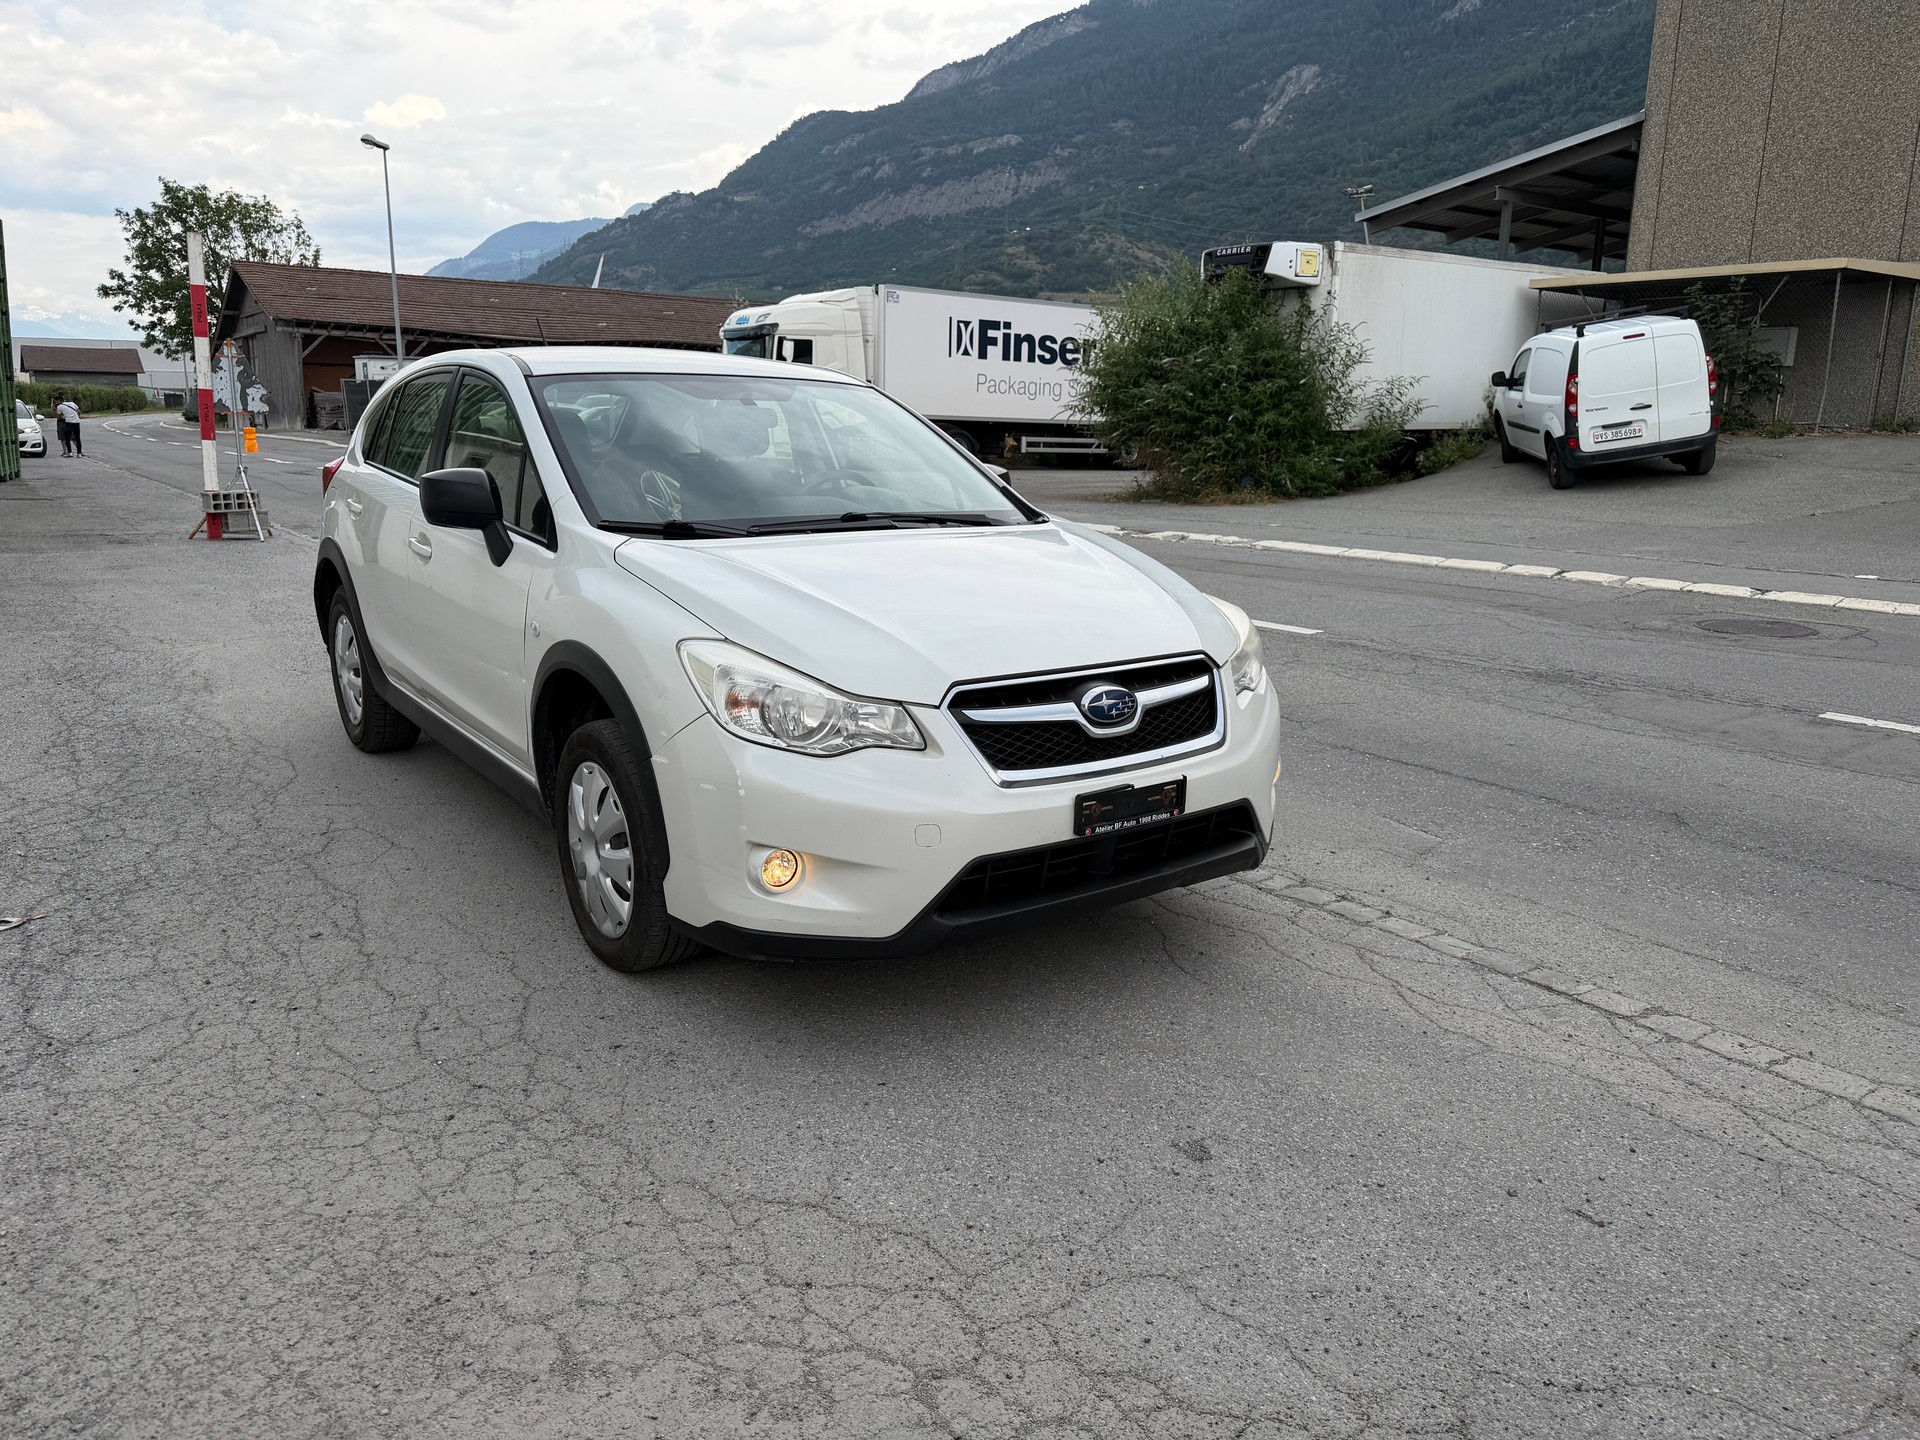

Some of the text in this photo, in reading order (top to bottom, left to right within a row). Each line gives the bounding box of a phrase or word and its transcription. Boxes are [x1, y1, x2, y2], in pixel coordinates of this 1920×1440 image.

[1216, 246, 1252, 256] CARRIER
[976, 373, 1063, 402] Packaging
[1095, 825, 1114, 833] Atelier
[1114, 821, 1123, 830] BF
[1123, 820, 1137, 828] Auto
